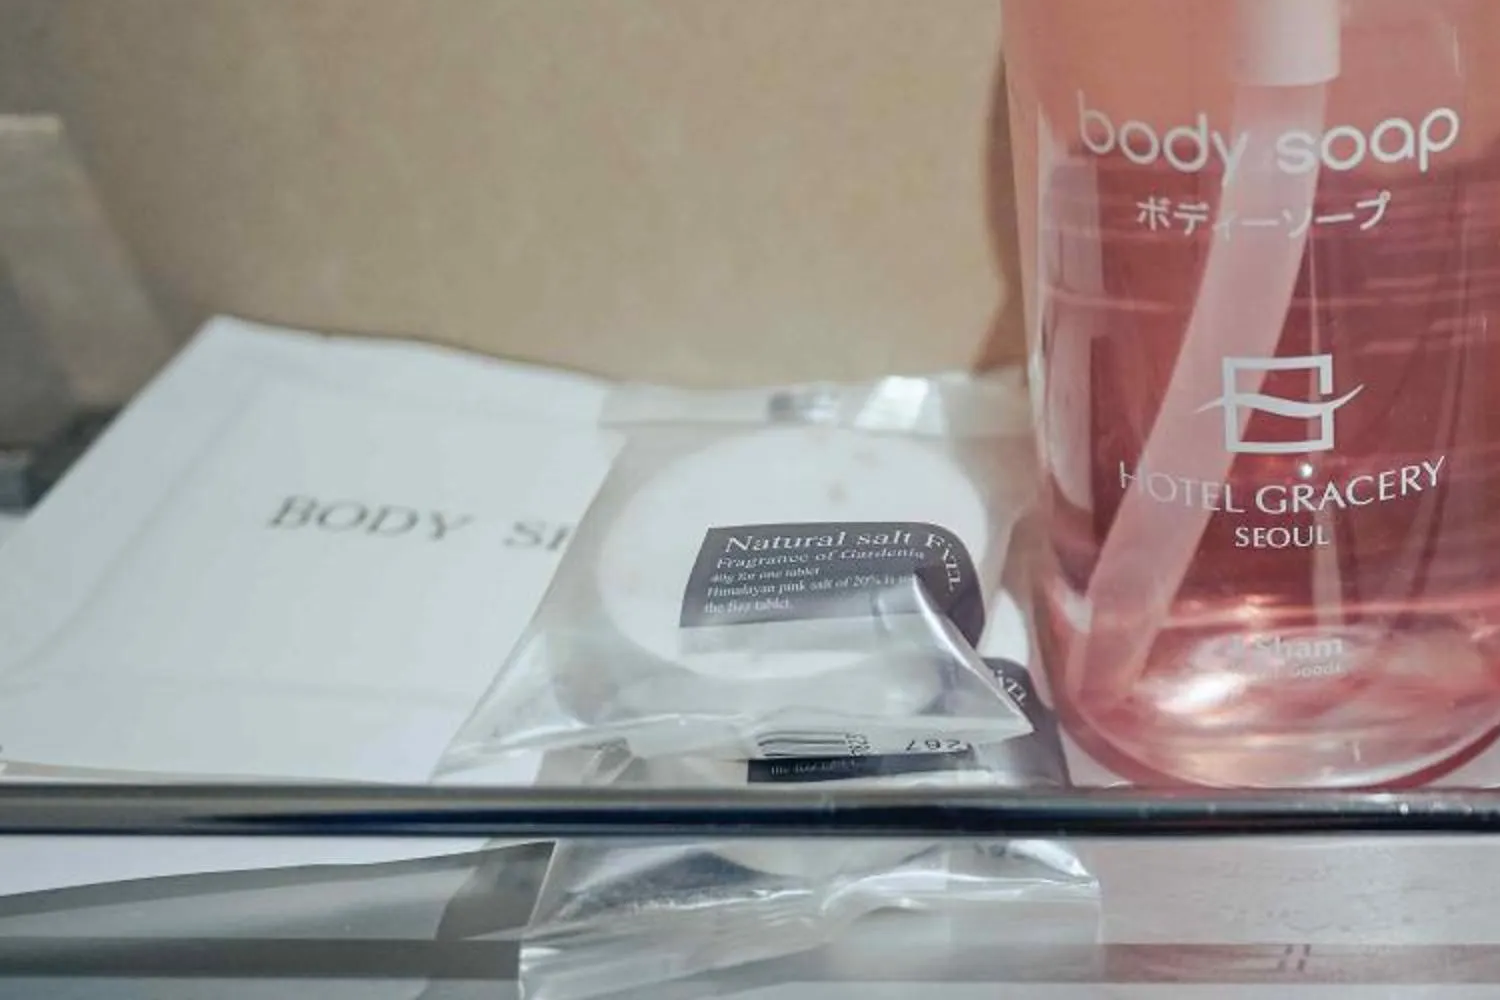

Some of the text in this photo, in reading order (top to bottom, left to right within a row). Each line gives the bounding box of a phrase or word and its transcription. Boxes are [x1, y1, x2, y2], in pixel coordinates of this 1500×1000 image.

[1076, 88, 1460, 187] body soap
[1135, 190, 1392, 240] ボディーソープ
[1119, 455, 1446, 516] HOTEL GRACERY
[267, 494, 477, 542] BODY
[724, 531, 847, 553] Natural
[856, 530, 912, 546] salt
[1234, 524, 1331, 549] SEOUL
[716, 554, 810, 570] Fragrance
[815, 550, 839, 562] of
[707, 583, 776, 597] Himalayan
